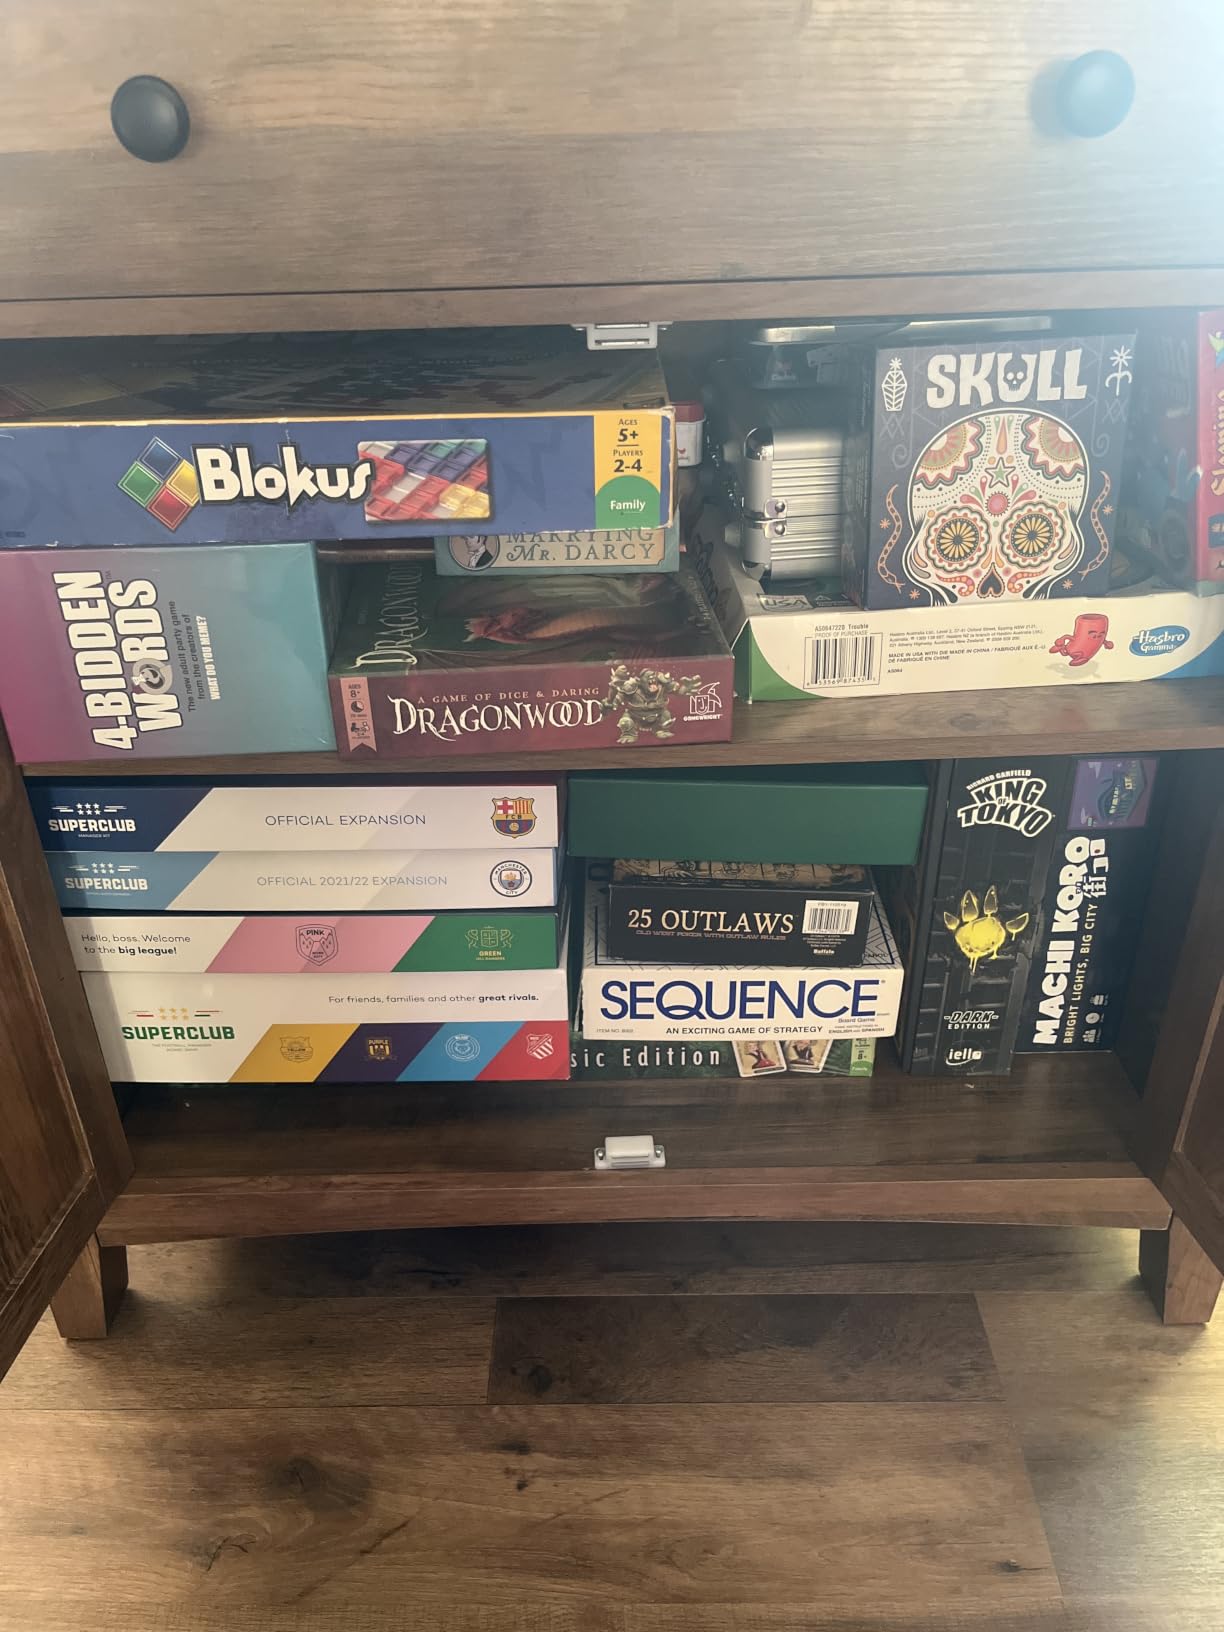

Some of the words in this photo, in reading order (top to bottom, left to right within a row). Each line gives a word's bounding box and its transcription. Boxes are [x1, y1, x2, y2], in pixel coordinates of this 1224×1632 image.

[926, 348, 1088, 409] SKULL
[617, 428, 639, 442] 5+
[195, 444, 372, 507] Blokus
[614, 459, 643, 473] 2-4
[610, 499, 646, 512] Family
[565, 543, 655, 561] DARCY
[168, 601, 180, 626] game
[182, 614, 190, 624] of
[174, 628, 186, 650] party
[196, 615, 210, 646] MEME?
[1134, 630, 1185, 645] Hasbro
[185, 626, 198, 662] creators
[53, 570, 138, 750] 4-BIDDEN
[178, 653, 188, 675] adult
[202, 646, 214, 663] YOU
[192, 664, 201, 678] the
[205, 664, 216, 676] DO
[183, 678, 192, 694] new
[196, 680, 205, 700] from
[207, 676, 220, 700] WHAT
[432, 695, 467, 703] GAME
[536, 690, 544, 698] &
[552, 688, 600, 697] DARING
[188, 696, 196, 712] The
[387, 695, 603, 742] DRAGONWOOD
[966, 774, 995, 790] RICHARD
[996, 770, 1032, 779] GARFIELD
[970, 778, 1047, 807] KING
[48, 819, 137, 832] SUPERCLUB
[264, 815, 334, 826] OFFICIAL
[339, 814, 427, 825] EXPANSION
[957, 802, 1053, 838] TOKYO
[64, 878, 148, 890] SUPERCLUB
[256, 876, 316, 887] OFFICIAL
[320, 876, 370, 887] 2021/22
[372, 875, 448, 886] EXPANSION
[1052, 836, 1091, 933] KORO
[628, 908, 652, 928] 25
[661, 910, 794, 934] OUTLAWS
[1084, 903, 1098, 929] CITY
[81, 934, 112, 944] Hello,
[112, 934, 140, 943] boss.
[142, 934, 191, 943] Welcome
[1079, 934, 1092, 954] BIG
[84, 946, 96, 954] to
[98, 946, 116, 954] the
[118, 946, 136, 956] big
[138, 946, 177, 956] league!
[1072, 958, 1088, 1001] LIGHTS,
[346, 995, 384, 1004] friends,
[386, 995, 426, 1003] families
[428, 994, 446, 1002] and
[449, 994, 476, 1002] other
[478, 994, 506, 1003] great
[508, 993, 540, 1002] rivals.
[600, 978, 880, 1020] SEQUENCE
[1033, 940, 1075, 1044] MACHI
[950, 1011, 993, 1024] DARK
[1063, 1004, 1080, 1044] BRIGHT
[121, 1026, 236, 1040] SUPERCLUB
[728, 1026, 756, 1034] GAME
[758, 1026, 772, 1034] OF
[774, 1026, 822, 1034] STRATEGY
[623, 1046, 720, 1067] Edition
[948, 1048, 982, 1061] iello
